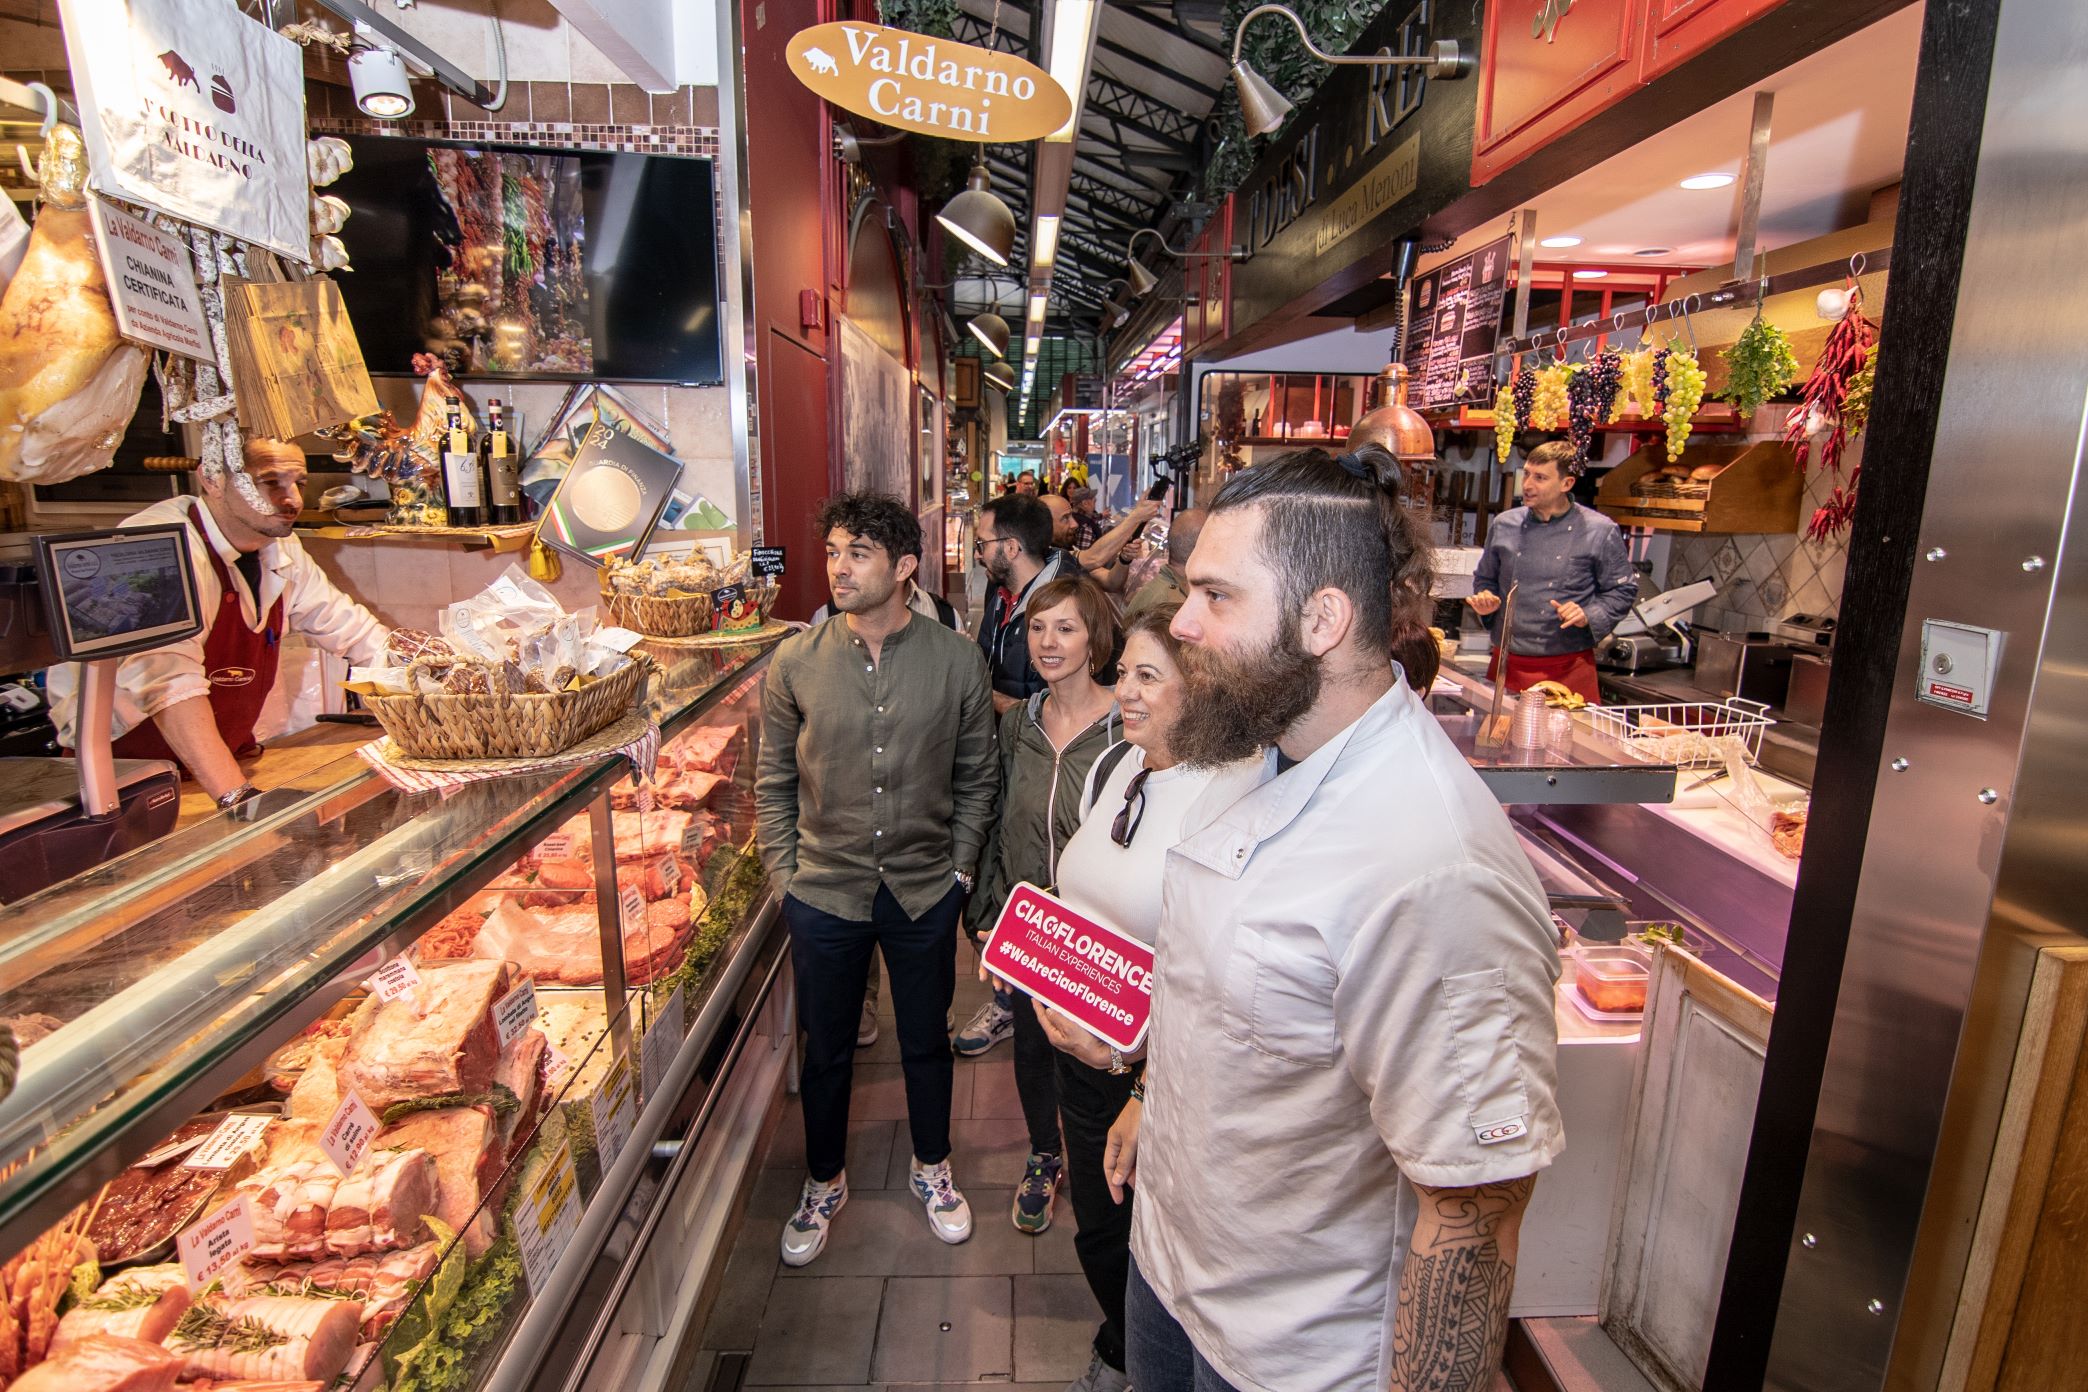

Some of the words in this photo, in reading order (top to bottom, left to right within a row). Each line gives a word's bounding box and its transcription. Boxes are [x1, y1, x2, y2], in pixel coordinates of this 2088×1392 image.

[841, 26, 1036, 100] Valdarno
[868, 78, 992, 135] Carni
[165, 131, 252, 180] VALDARNO
[221, 131, 265, 164] DELLA
[1331, 200, 1358, 241] Luca
[1360, 153, 1416, 219] Menoni
[104, 212, 118, 237] La
[116, 215, 156, 252] Valdarno
[155, 235, 181, 267] Carni
[126, 255, 175, 288] CHIANINA
[123, 275, 189, 312] CERTIFICATA
[590, 435, 608, 450] 24
[595, 425, 615, 440] 20
[621, 464, 628, 472] DI
[628, 469, 647, 496] FINANZA
[1026, 929, 1060, 956] ITALIAN
[1000, 941, 1135, 1026] #WeAreCiaoFlorence
[1059, 952, 1122, 995] EXPERIENCES
[344, 1099, 358, 1115] Carni
[327, 1136, 336, 1147] La
[330, 1113, 347, 1138] Valdarno
[345, 1142, 351, 1152] di
[349, 1125, 362, 1145] suino
[345, 1160, 352, 1169] €
[191, 1235, 200, 1249] La
[199, 1216, 226, 1239] Valdarno
[225, 1203, 242, 1221] Carni
[208, 1229, 230, 1248] Arista
[197, 1271, 205, 1282] €
[207, 1251, 231, 1275] 13,50
[240, 1242, 249, 1250] kg
[209, 1238, 232, 1258] legata
